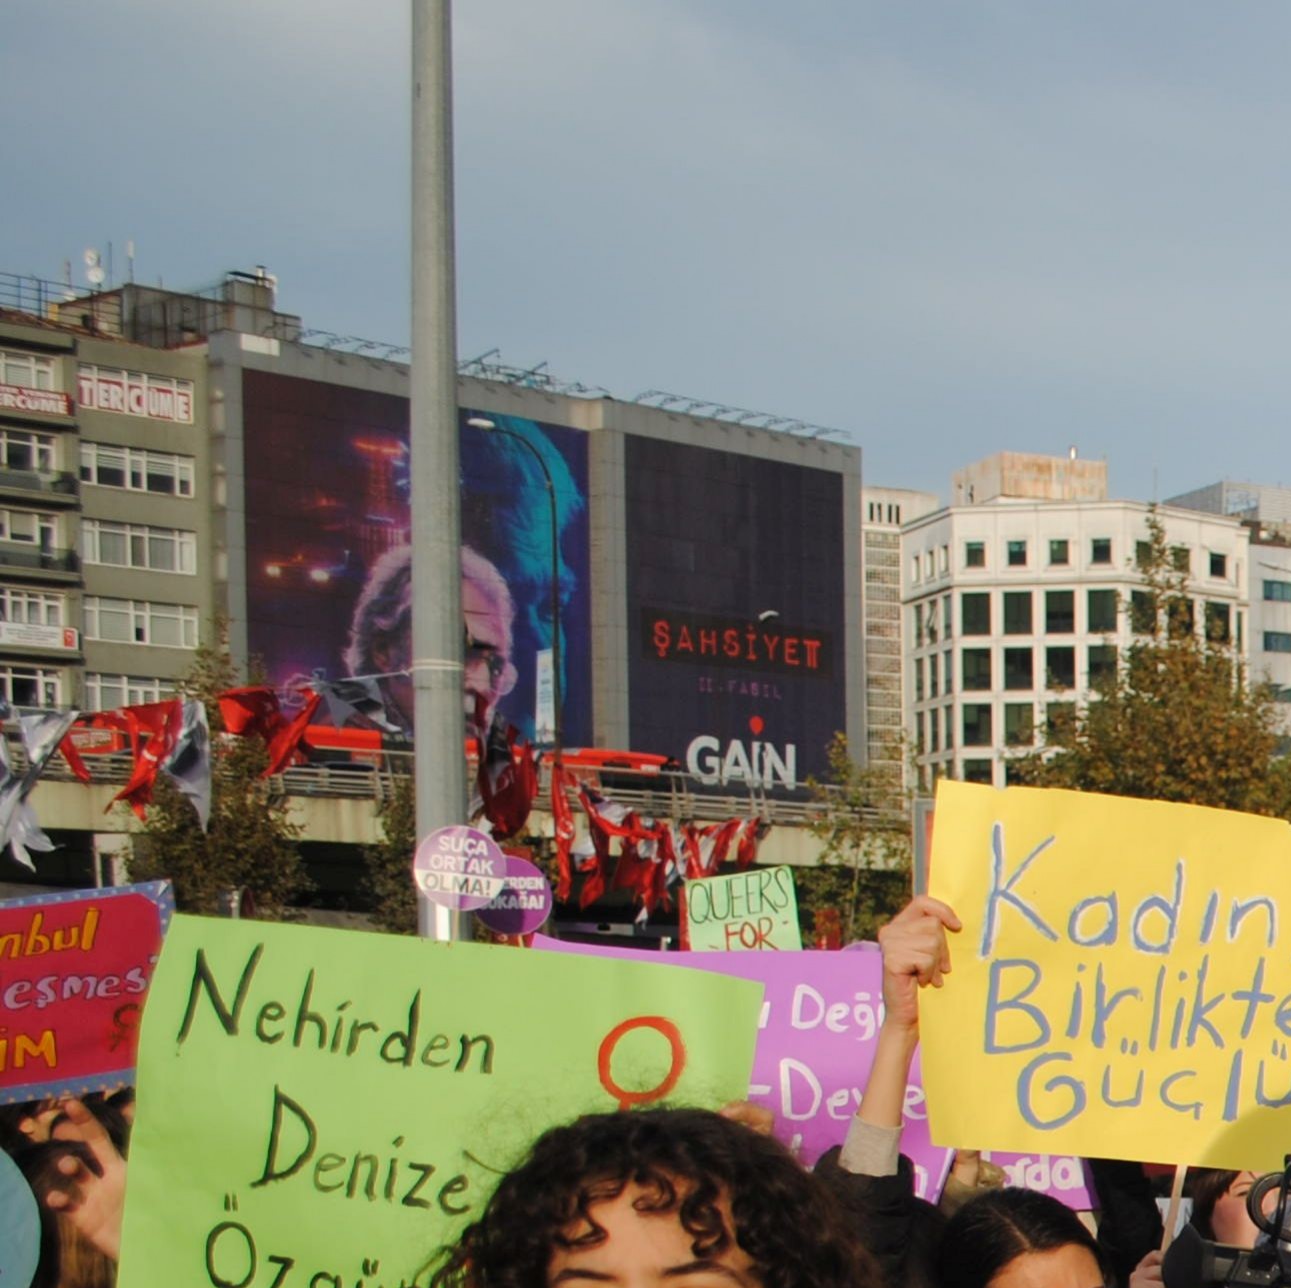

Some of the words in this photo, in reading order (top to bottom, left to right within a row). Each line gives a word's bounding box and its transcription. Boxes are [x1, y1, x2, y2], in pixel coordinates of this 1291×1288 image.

[430, 854, 494, 876] ORTAK
[439, 835, 489, 858] SUÇA
[423, 873, 492, 897] OLMA!
[688, 867, 789, 924] QUEERS
[725, 917, 779, 951] FOR
[4, 955, 158, 1009] eşmes
[176, 943, 494, 1074] Nehirden
[250, 1085, 472, 1216] Denize
